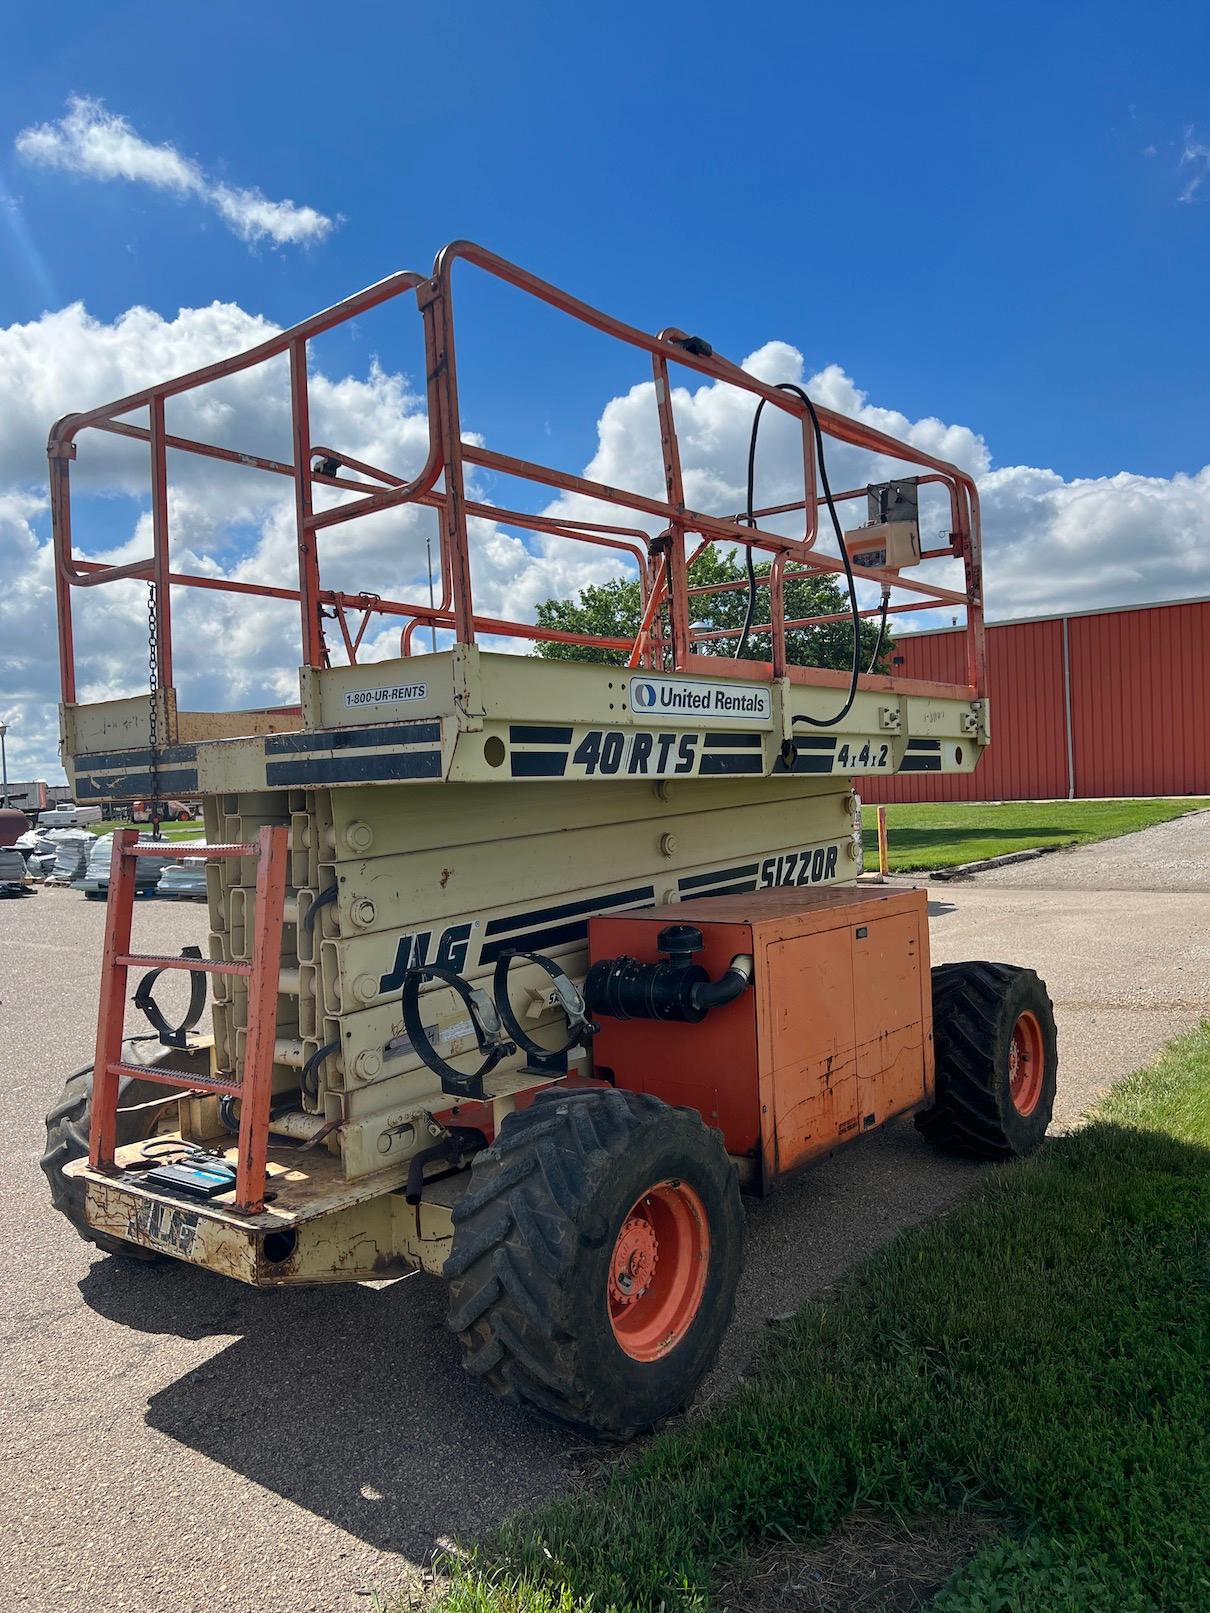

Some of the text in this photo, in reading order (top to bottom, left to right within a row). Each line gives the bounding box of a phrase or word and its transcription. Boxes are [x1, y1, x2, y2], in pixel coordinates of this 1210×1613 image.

[346, 685, 425, 705] 1-800-UR-RENTS
[660, 687, 764, 712] United Rentals
[760, 845, 838, 890] SIZZOR
[378, 922, 473, 994] JLG
